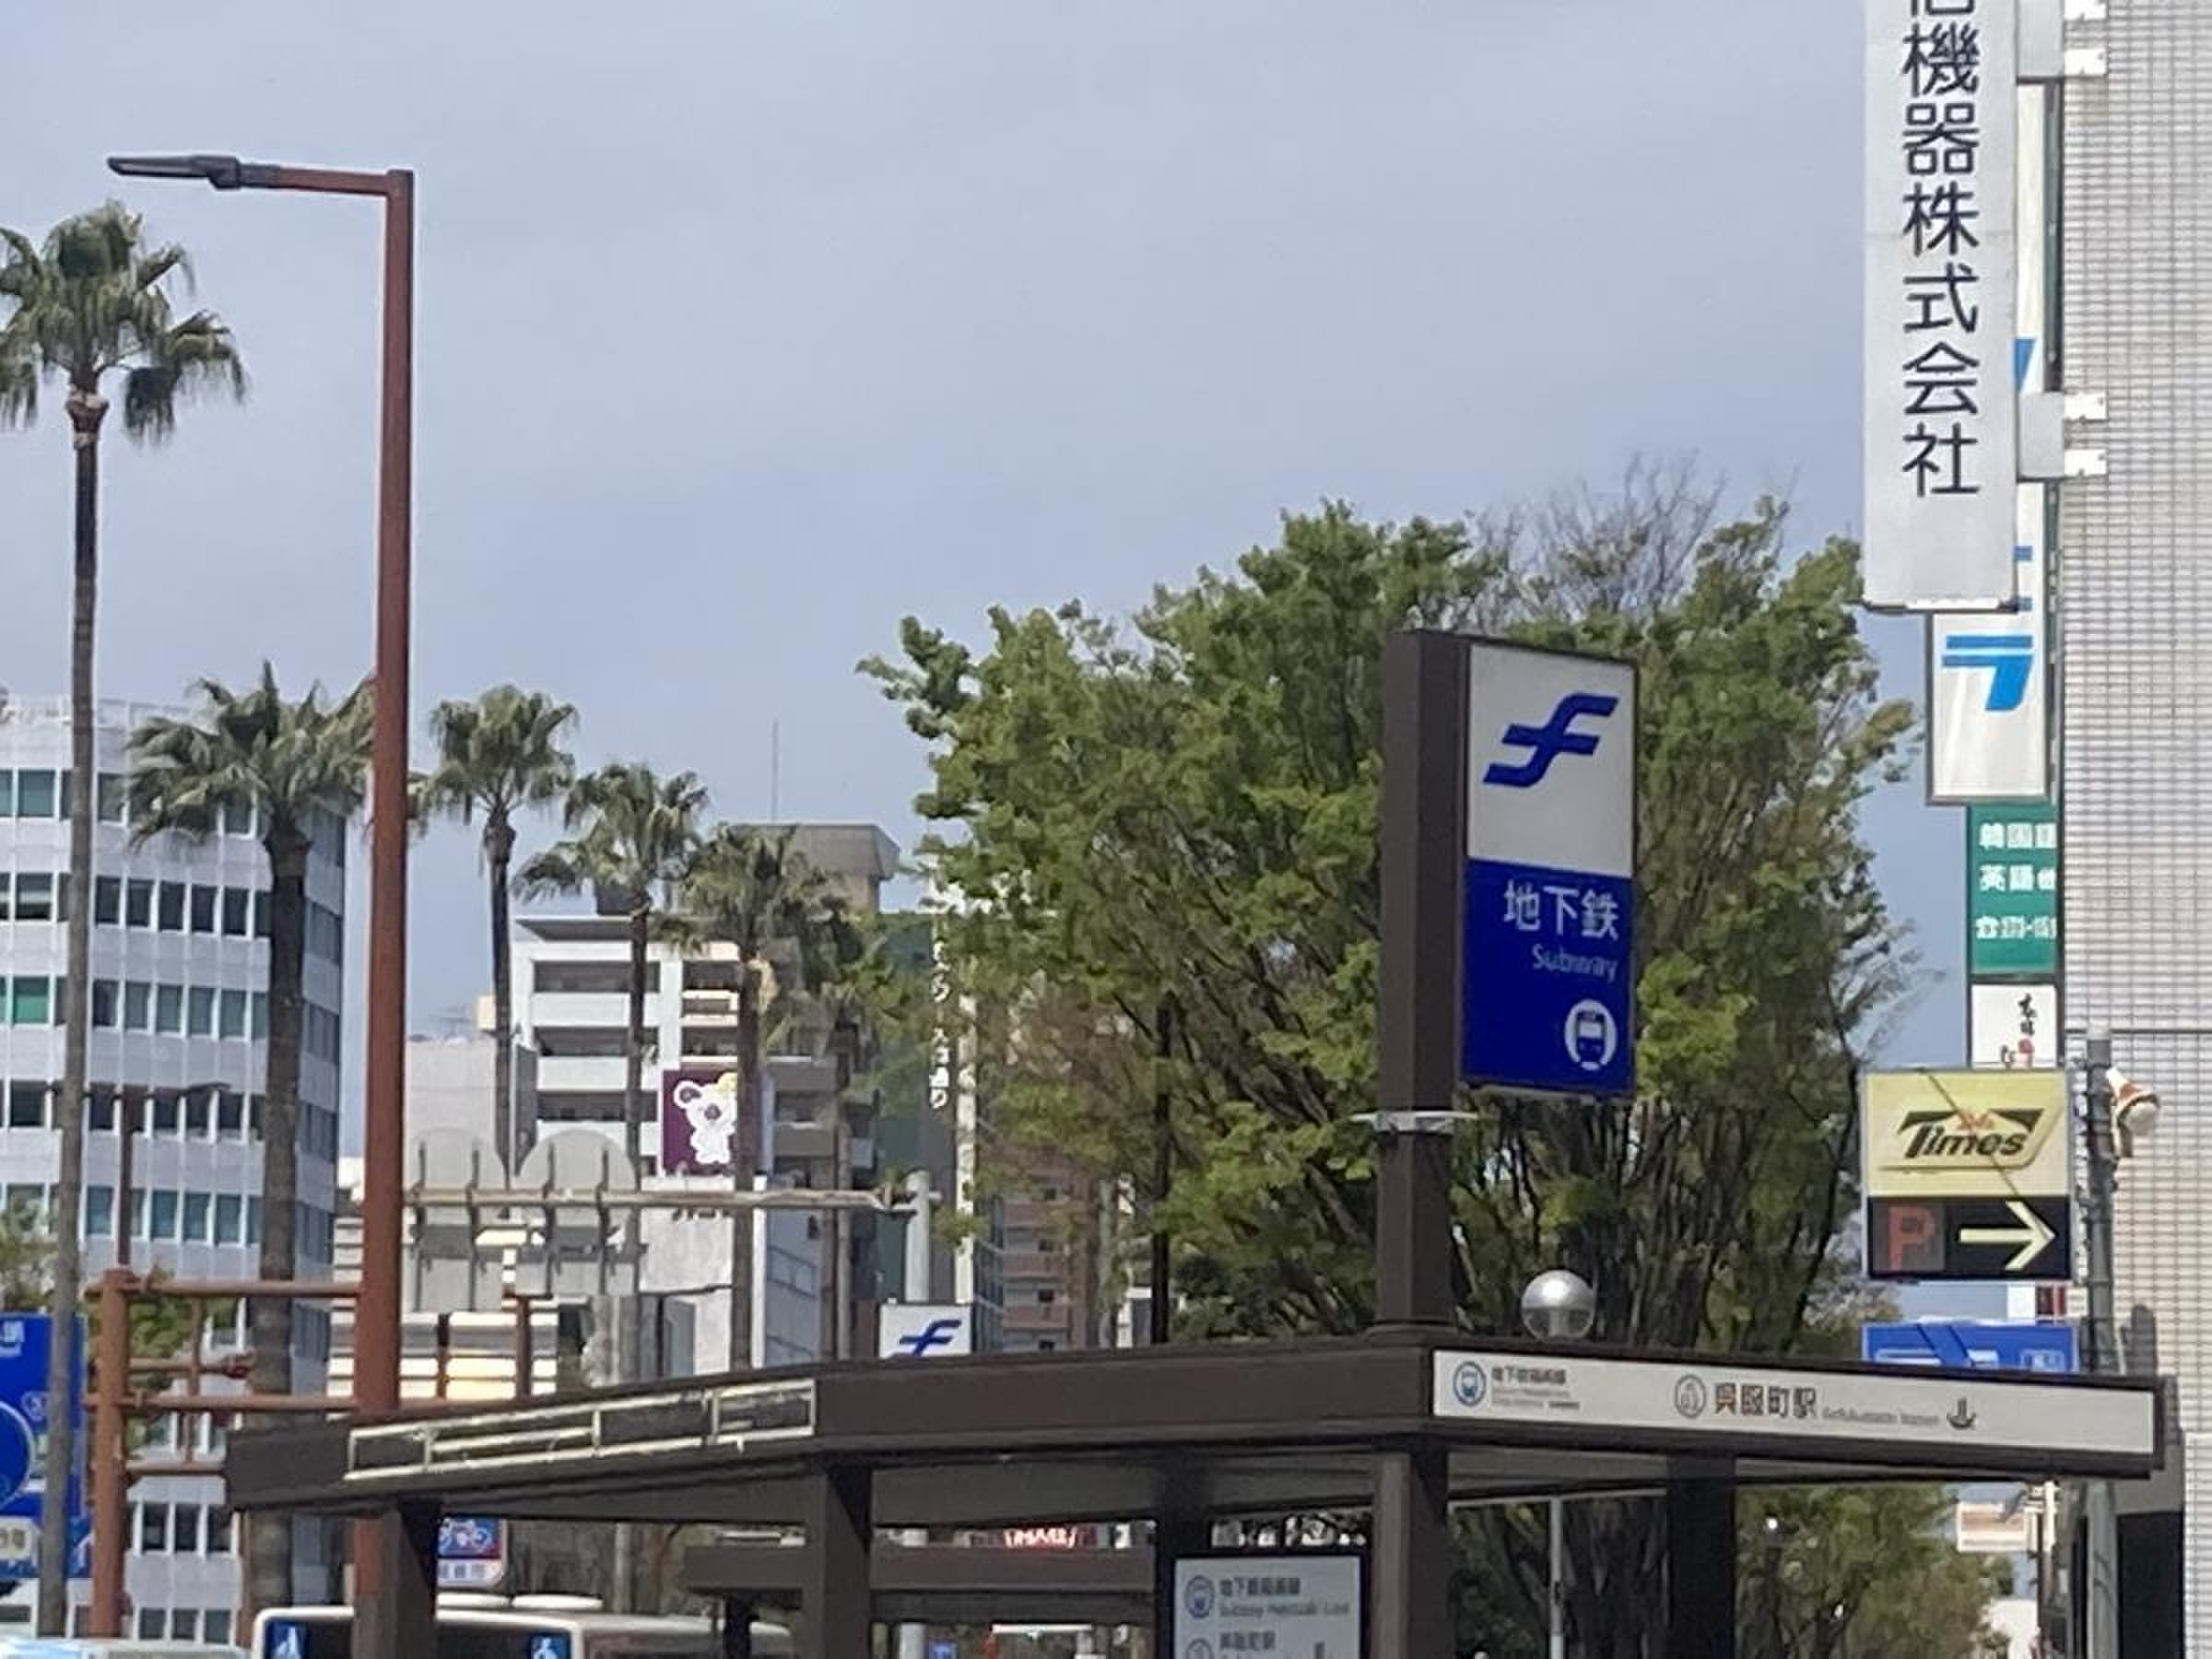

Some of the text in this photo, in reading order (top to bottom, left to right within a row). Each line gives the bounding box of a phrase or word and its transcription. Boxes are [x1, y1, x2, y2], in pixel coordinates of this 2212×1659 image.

[1502, 879, 1619, 941] 地下鉄
[1532, 943, 1618, 982] Subway
[1897, 1108, 2044, 1159] Times
[1888, 1206, 1935, 1270] P
